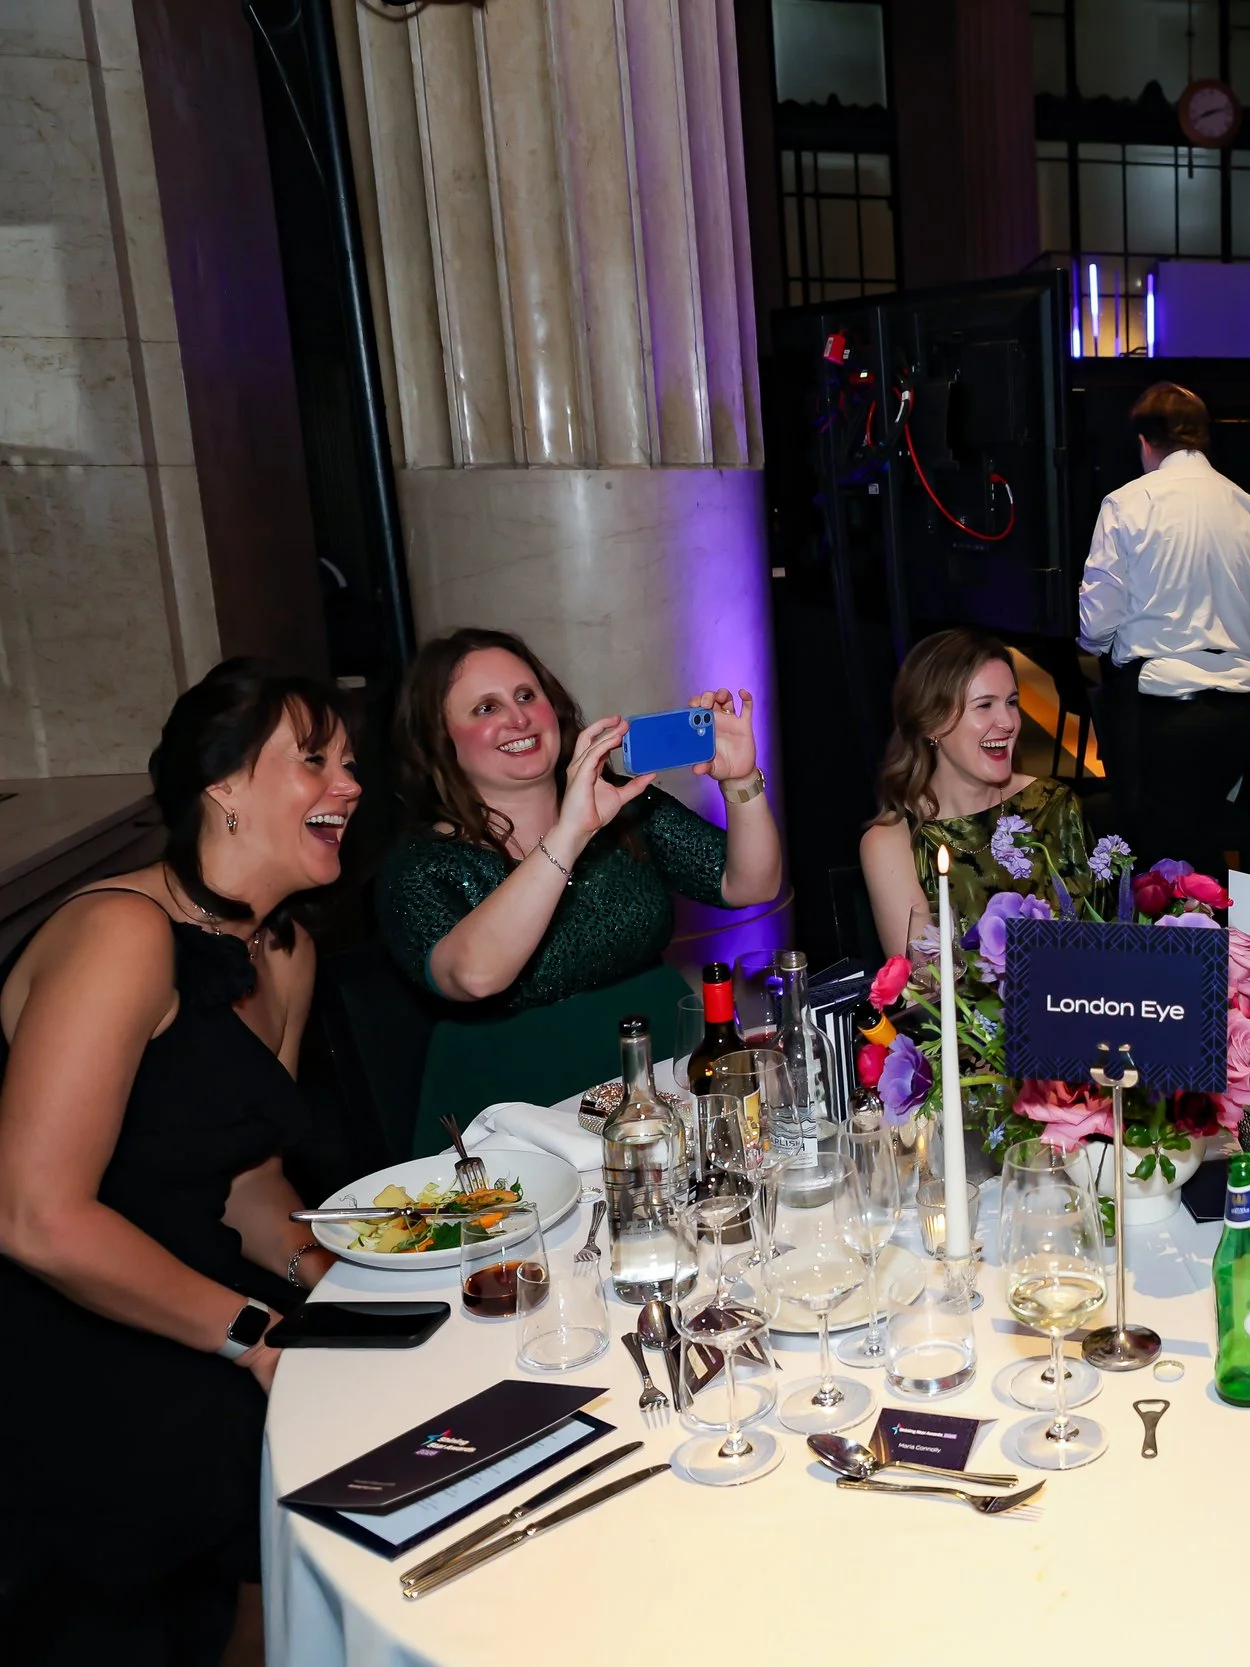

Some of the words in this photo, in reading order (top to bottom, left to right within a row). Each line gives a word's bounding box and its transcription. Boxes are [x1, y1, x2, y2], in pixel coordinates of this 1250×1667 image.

[1046, 994, 1134, 1017] London
[1141, 1000, 1185, 1022] Eye
[898, 1442, 915, 1450] Maria
